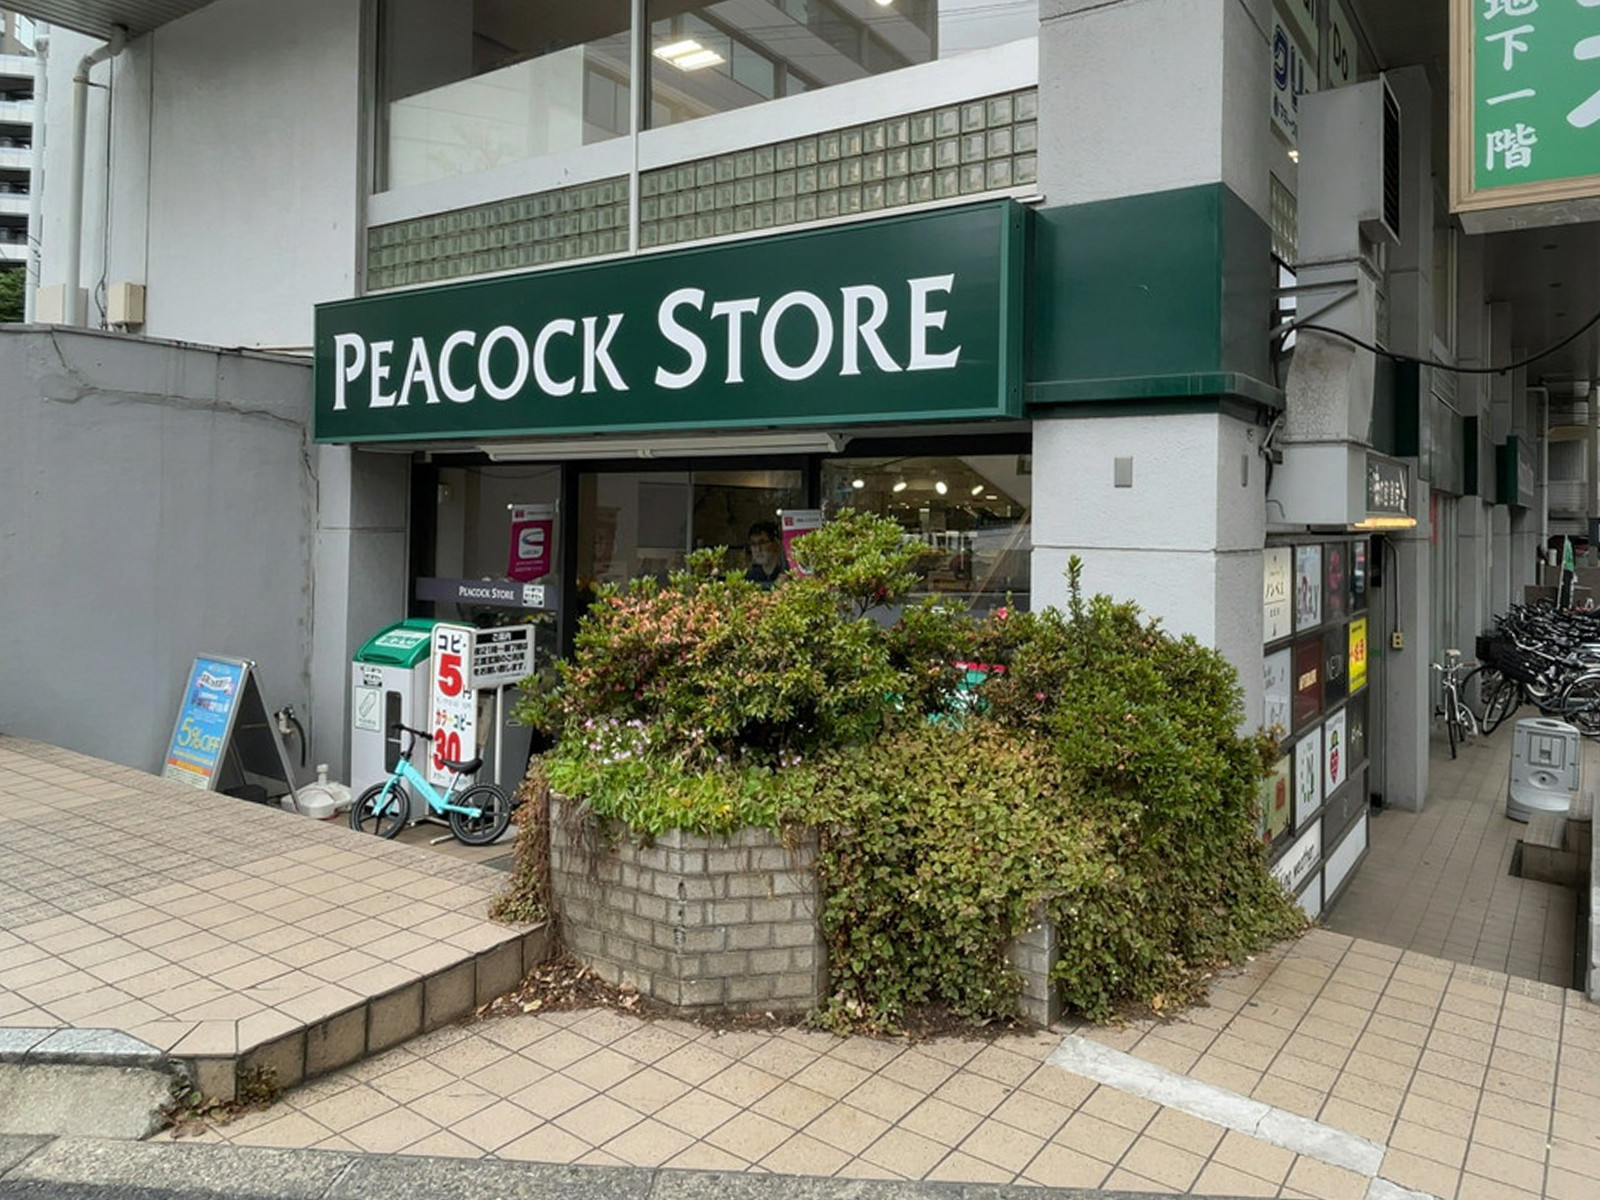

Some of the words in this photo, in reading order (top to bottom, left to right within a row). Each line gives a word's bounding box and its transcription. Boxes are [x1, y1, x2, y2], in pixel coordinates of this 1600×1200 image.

[333, 313, 629, 411] PEACOCK
[654, 273, 962, 390] STORE
[458, 586, 490, 599] PEACOCK
[491, 587, 515, 601] STORE
[438, 653, 463, 697] 5
[433, 727, 461, 774] 30
